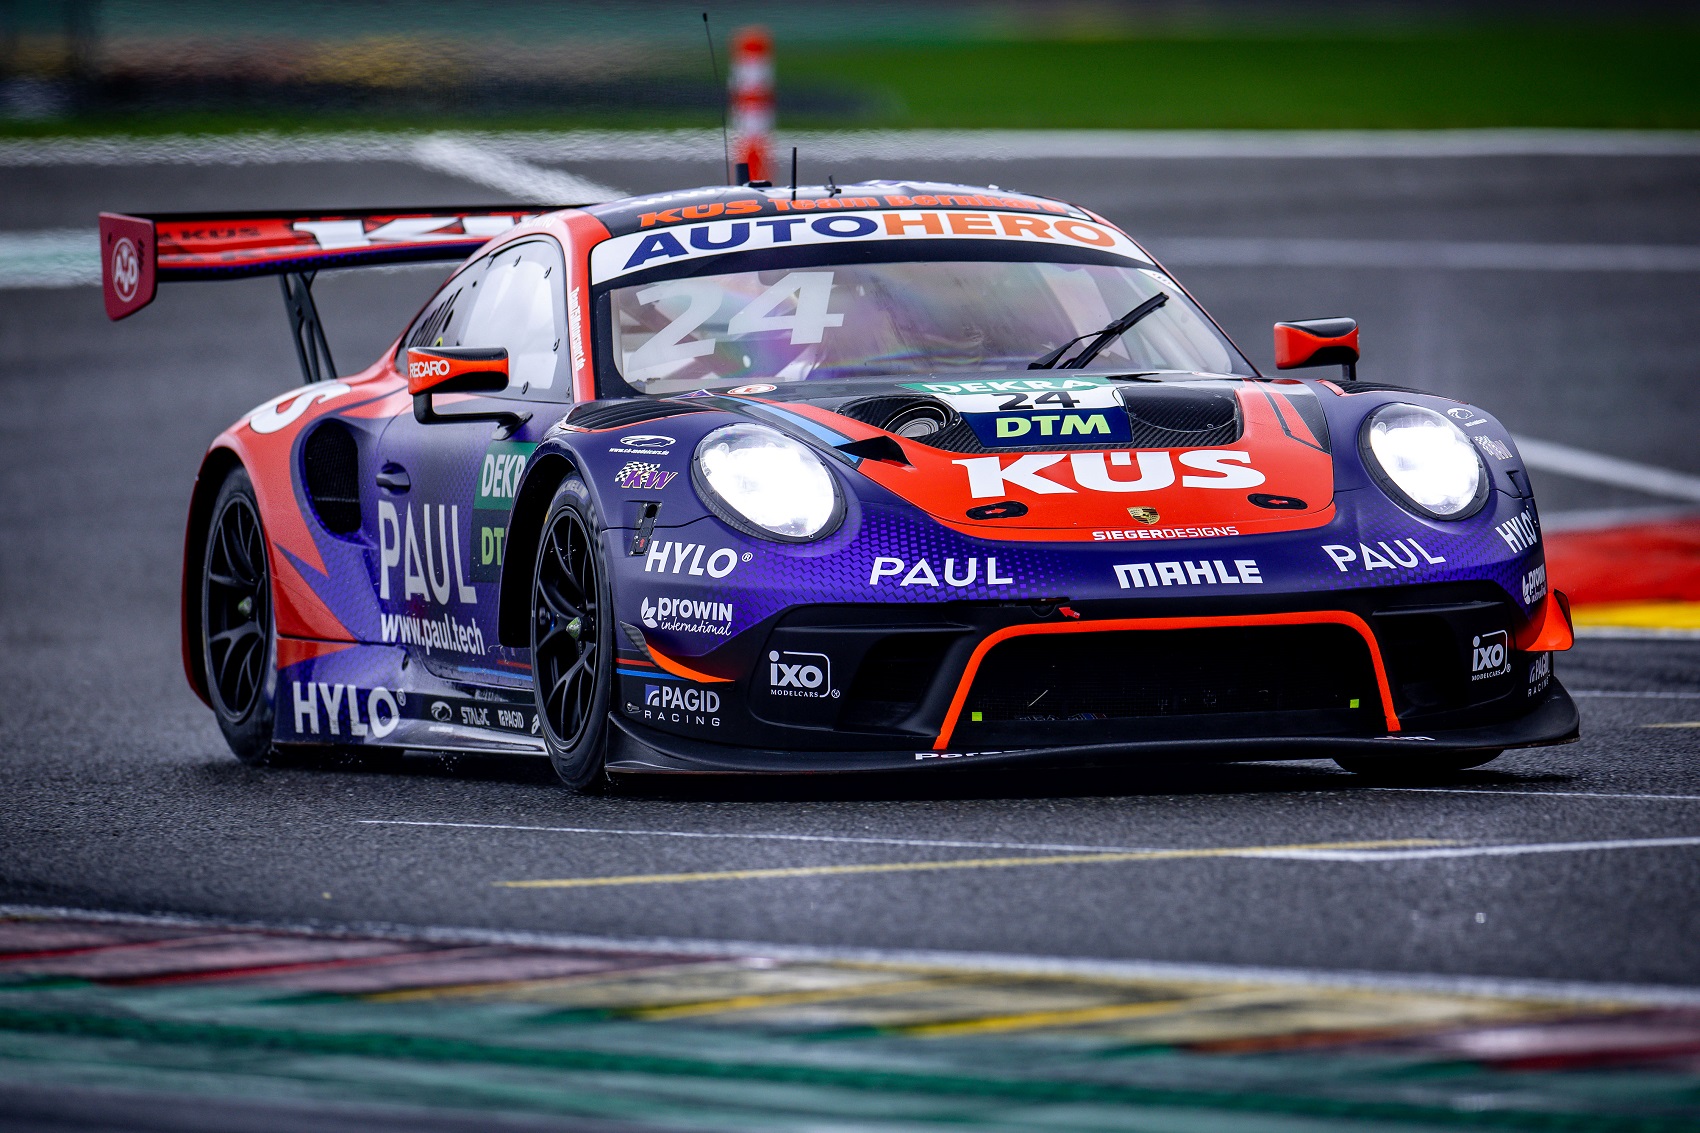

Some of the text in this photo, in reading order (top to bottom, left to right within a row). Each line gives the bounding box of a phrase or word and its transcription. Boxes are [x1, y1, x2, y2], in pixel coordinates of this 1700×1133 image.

[768, 197, 879, 211] Team
[628, 272, 844, 373] 24
[409, 360, 450, 378] RECARO
[922, 379, 1097, 394] DEKRA
[991, 391, 1080, 410] 24
[996, 414, 1111, 438] DTM
[621, 470, 679, 490] KW
[952, 450, 1266, 499] KÜS
[1092, 526, 1240, 541] SIEGERDESIGNS
[378, 500, 478, 605] PAUL
[1322, 537, 1447, 572] PAUL
[869, 556, 1014, 588] PAUL
[1113, 559, 1264, 589] MAHLE
[381, 612, 486, 656] www.paul.tech
[661, 617, 732, 636] international
[1472, 635, 1504, 672] ixo
[768, 650, 824, 689] ixo
[662, 686, 720, 713] PAGID
[770, 689, 819, 698] MODELCARS
[644, 710, 721, 727] RACING
